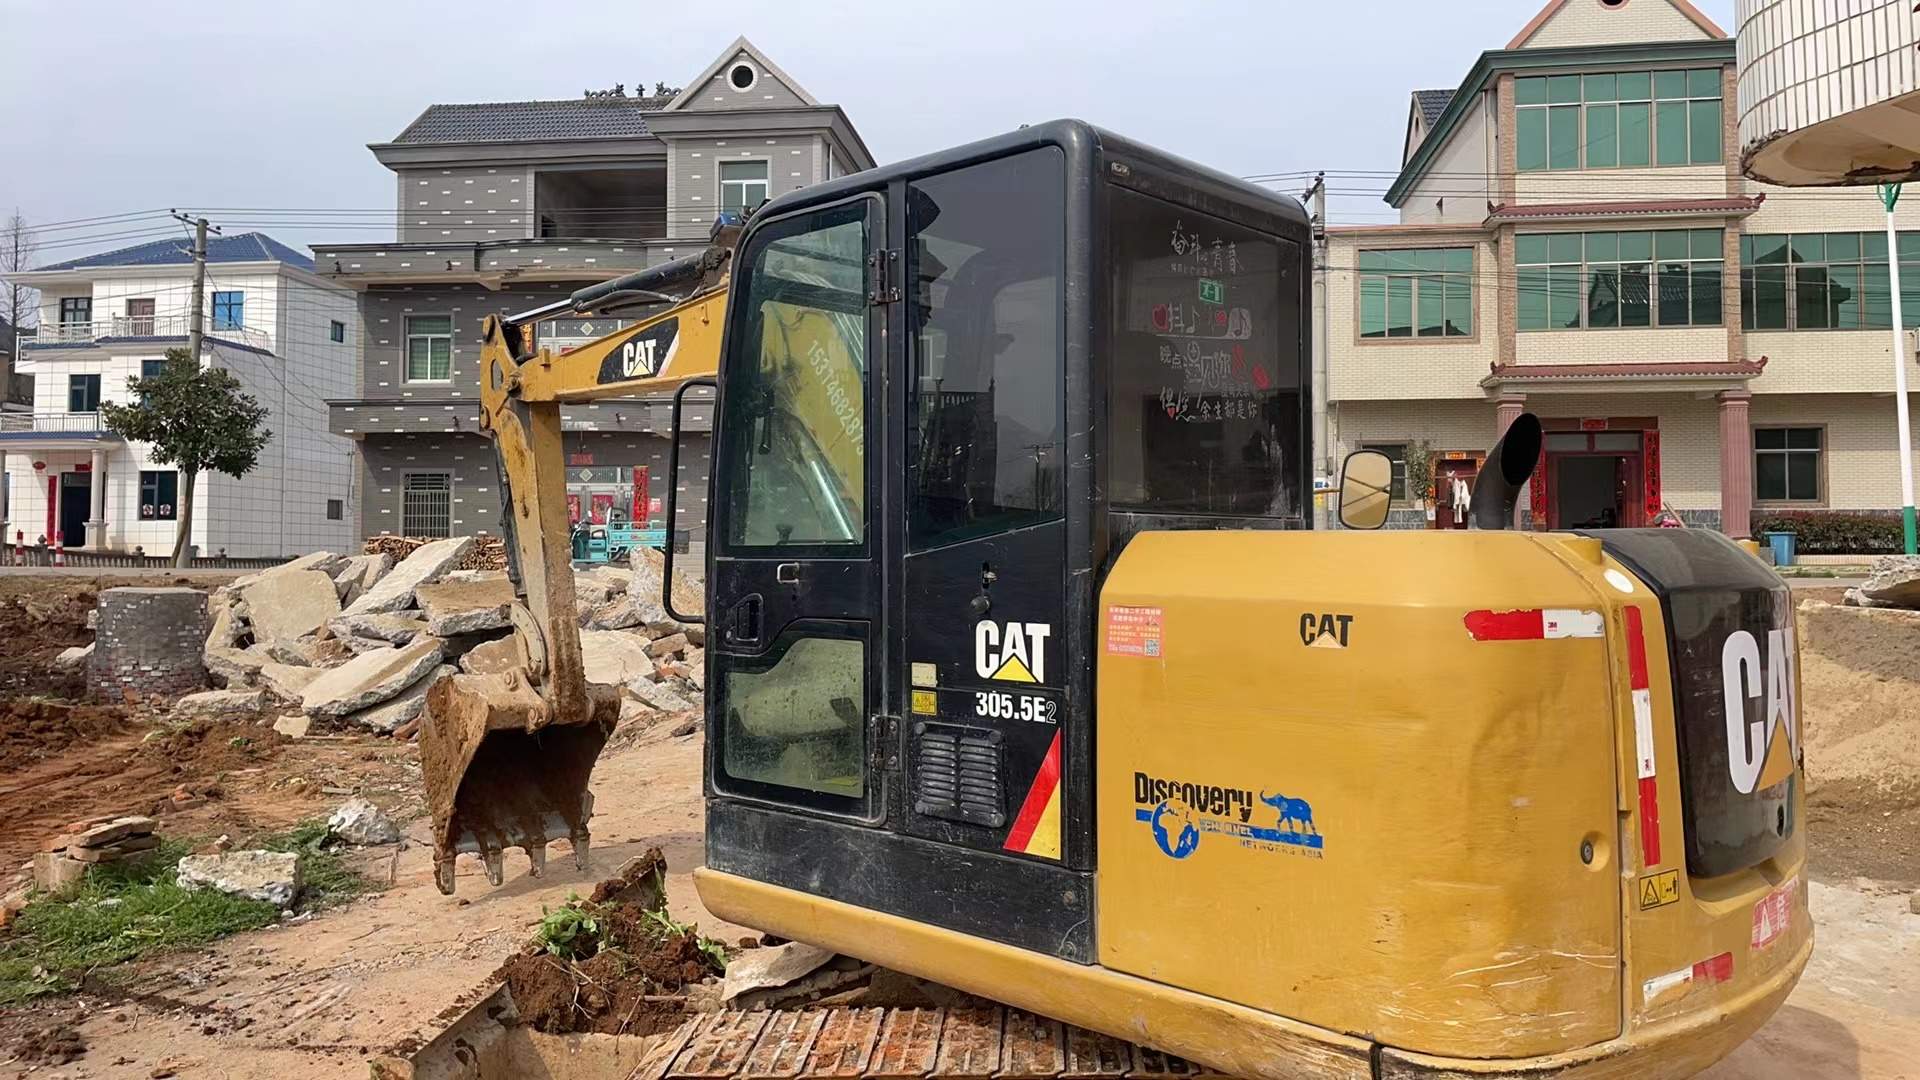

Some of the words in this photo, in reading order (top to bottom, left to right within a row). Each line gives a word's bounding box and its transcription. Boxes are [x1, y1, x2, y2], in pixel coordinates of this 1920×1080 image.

[622, 338, 657, 378] CAT
[1200, 400, 1257, 420] 余生都是你
[1300, 612, 1354, 647] CAT
[975, 619, 1051, 684] CAT
[975, 690, 1057, 724] 305.5E2
